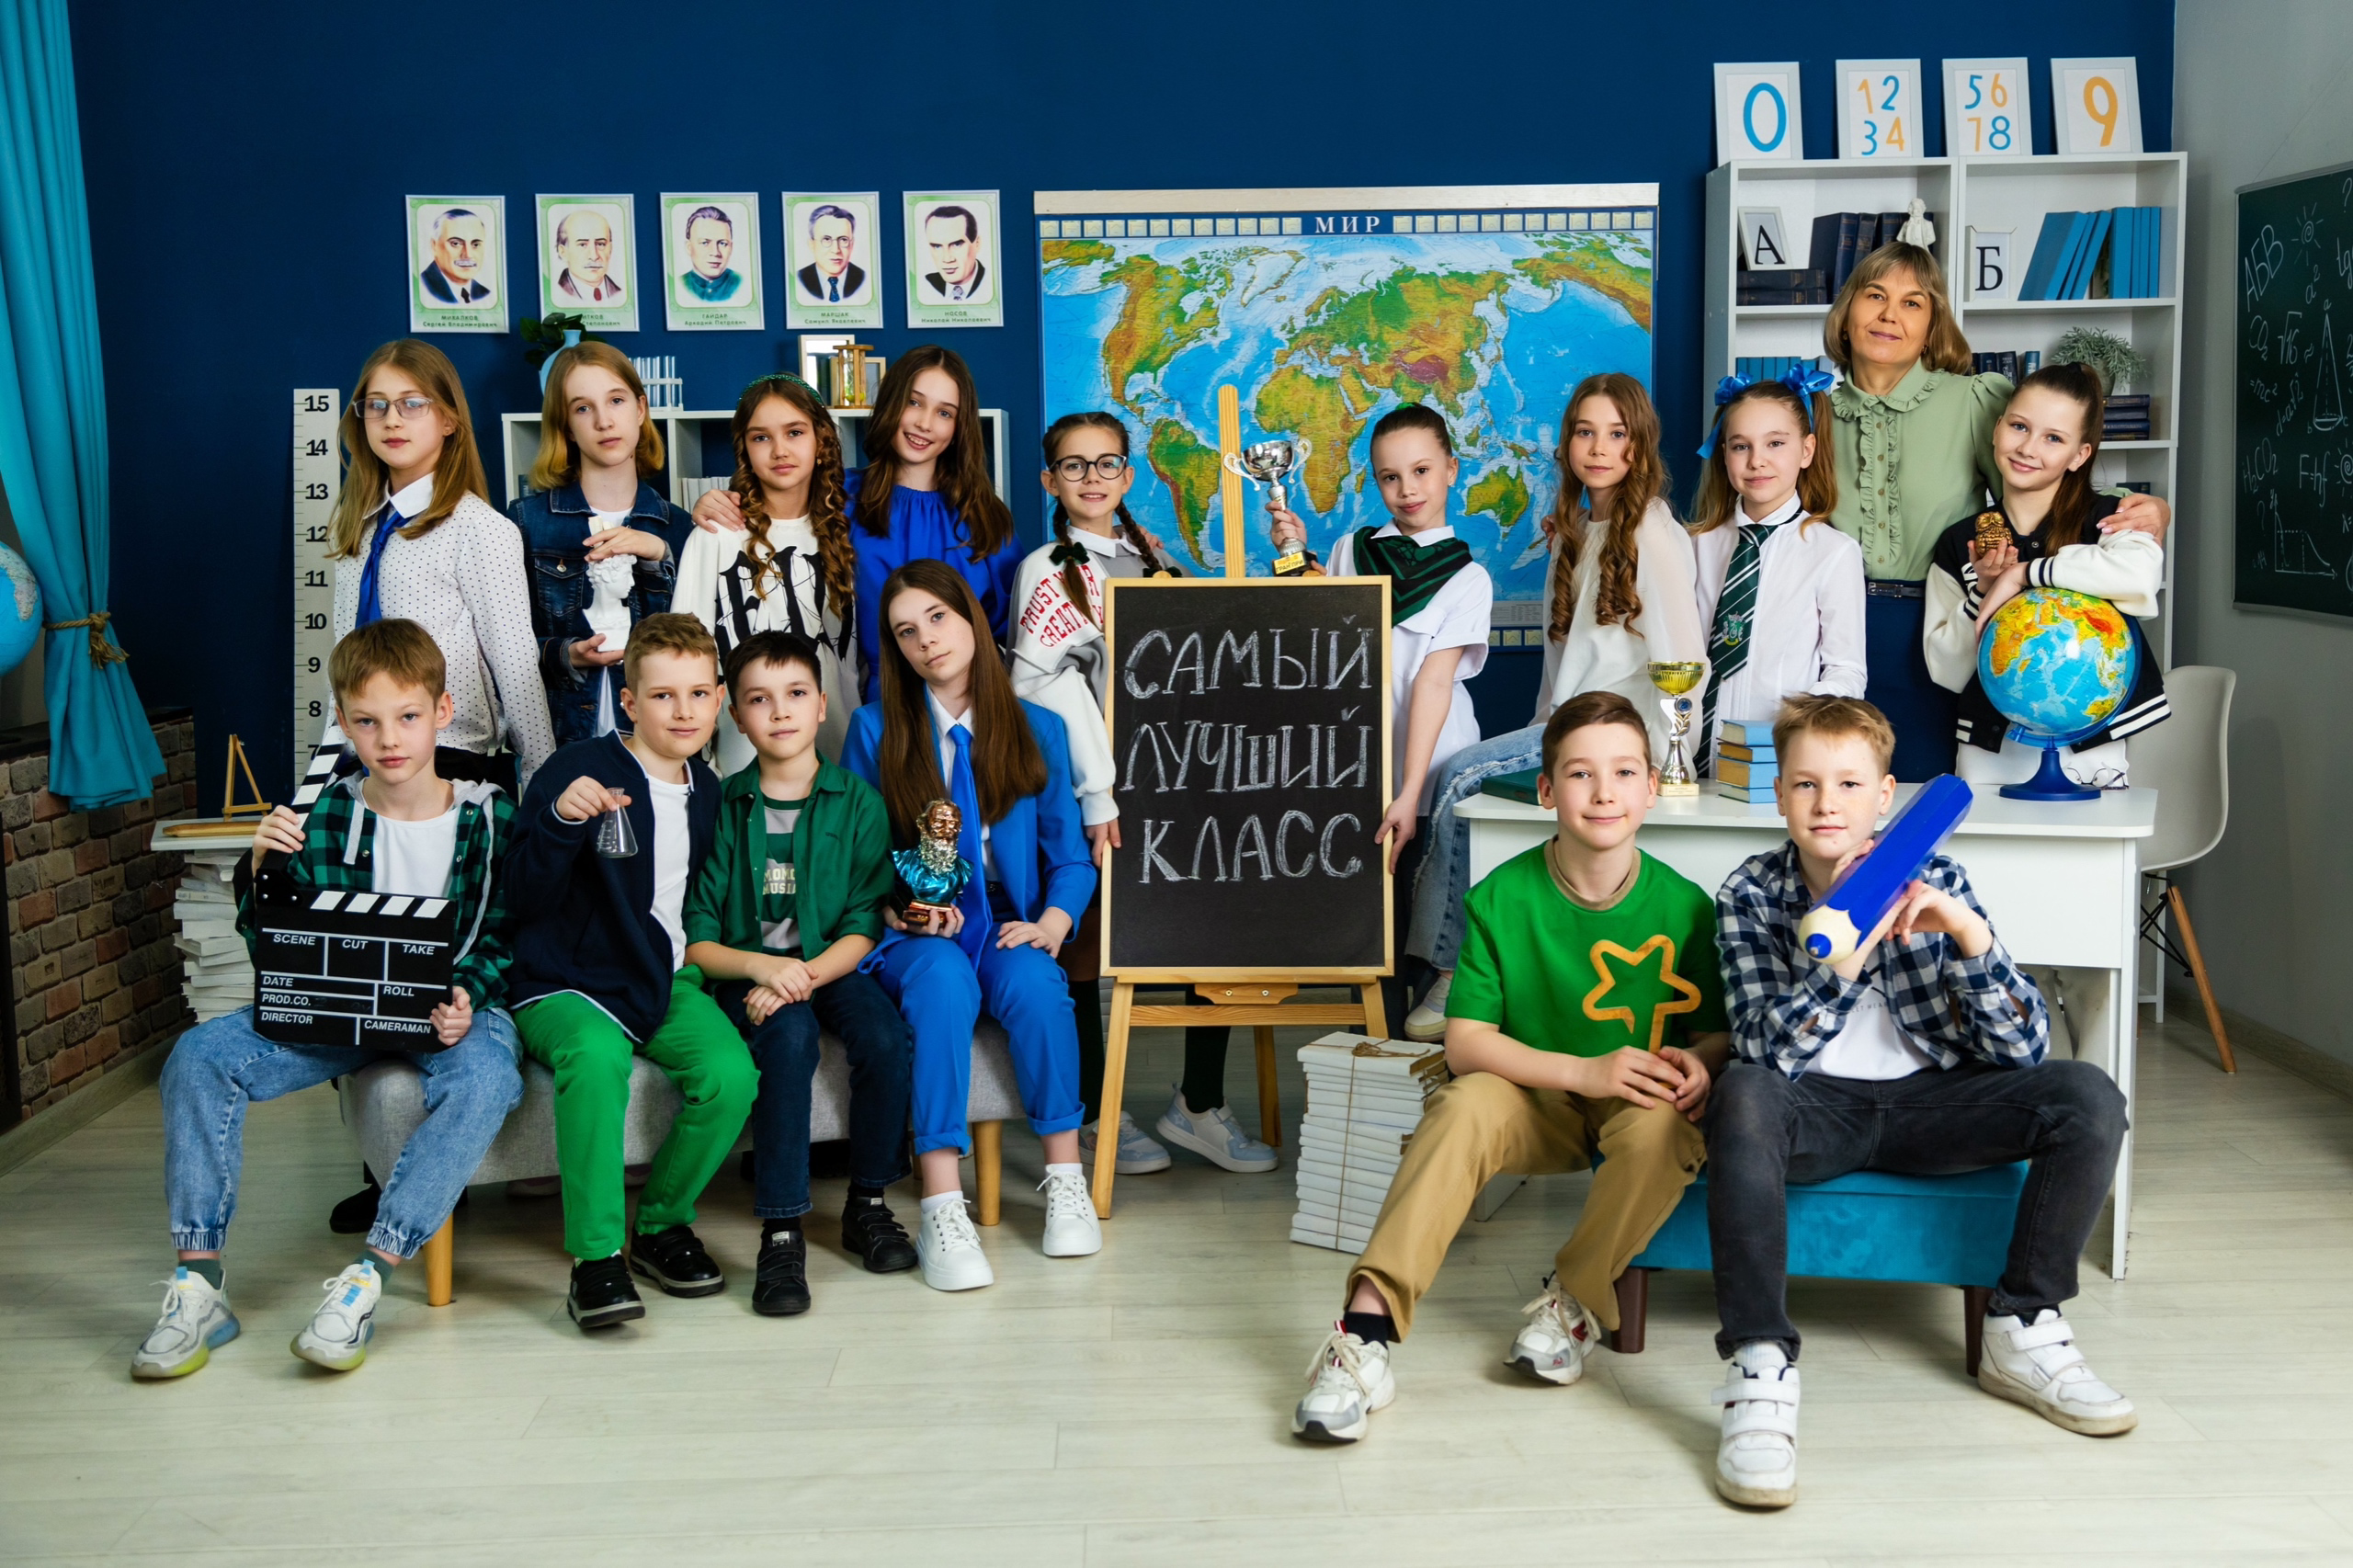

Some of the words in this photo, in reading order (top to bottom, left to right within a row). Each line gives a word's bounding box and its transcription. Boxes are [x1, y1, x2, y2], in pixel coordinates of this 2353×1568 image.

[1857, 79, 1873, 114] 1
[1881, 75, 1900, 111] 2
[1964, 74, 1983, 109] 5
[1991, 73, 2008, 108] 6
[1743, 82, 1787, 153] 0
[2083, 76, 2118, 147] 9
[1861, 120, 1878, 156] 3
[1886, 116, 1905, 152] 4
[1967, 117, 1982, 152] 7
[1988, 115, 2011, 151] 8
[1314, 215, 1381, 233] МИР
[1755, 224, 1786, 265] А
[1975, 246, 2003, 291] Б
[2245, 224, 2284, 312] АБВ
[304, 395, 329, 412] 15
[305, 439, 329, 456] 14
[305, 483, 329, 500] 13
[305, 526, 330, 542] 12
[304, 570, 329, 587] 11
[1019, 577, 1061, 634] TRUST
[304, 613, 327, 630] 10
[308, 656, 321, 673] 9
[1123, 614, 1374, 699] САМЫЙ
[308, 700, 322, 717] 8
[1119, 705, 1374, 793] ЛУЧШИЙ
[1138, 810, 1364, 883] КЛАСС
[273, 934, 317, 946] SCENE
[342, 939, 369, 949] CUT
[403, 944, 436, 955] TAKE
[263, 976, 294, 987] DATE
[383, 985, 415, 997] ROLL
[262, 994, 313, 1006] PROD.CO.
[261, 1012, 313, 1025] DIRECTOR
[364, 1020, 432, 1034] CAMERAMAN
